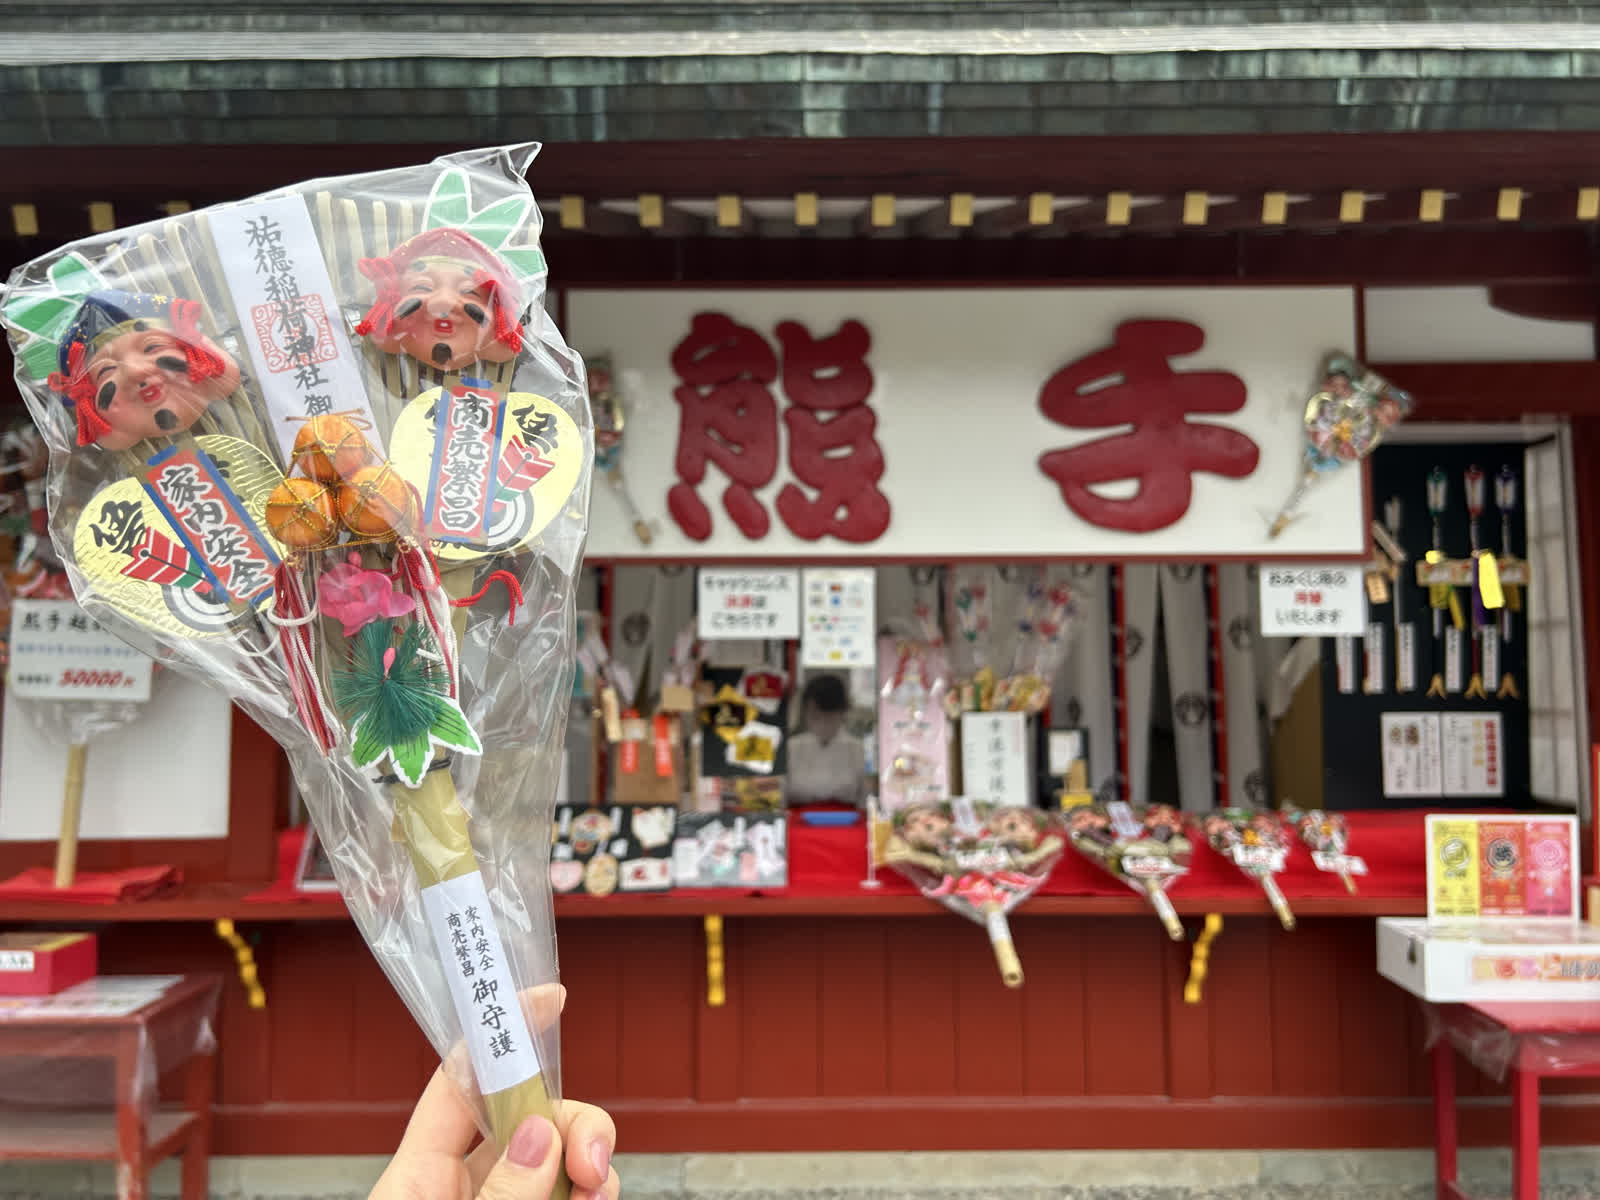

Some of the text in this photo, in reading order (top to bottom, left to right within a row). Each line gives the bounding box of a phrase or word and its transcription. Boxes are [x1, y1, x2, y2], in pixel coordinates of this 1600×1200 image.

[440, 393, 492, 531] 商売繁昌
[667, 311, 1261, 543] 熊手
[158, 465, 273, 598] 家内安全
[445, 912, 475, 977] 商売繁昌
[465, 905, 494, 971] 家内安全
[471, 977, 518, 1059] 御守護
